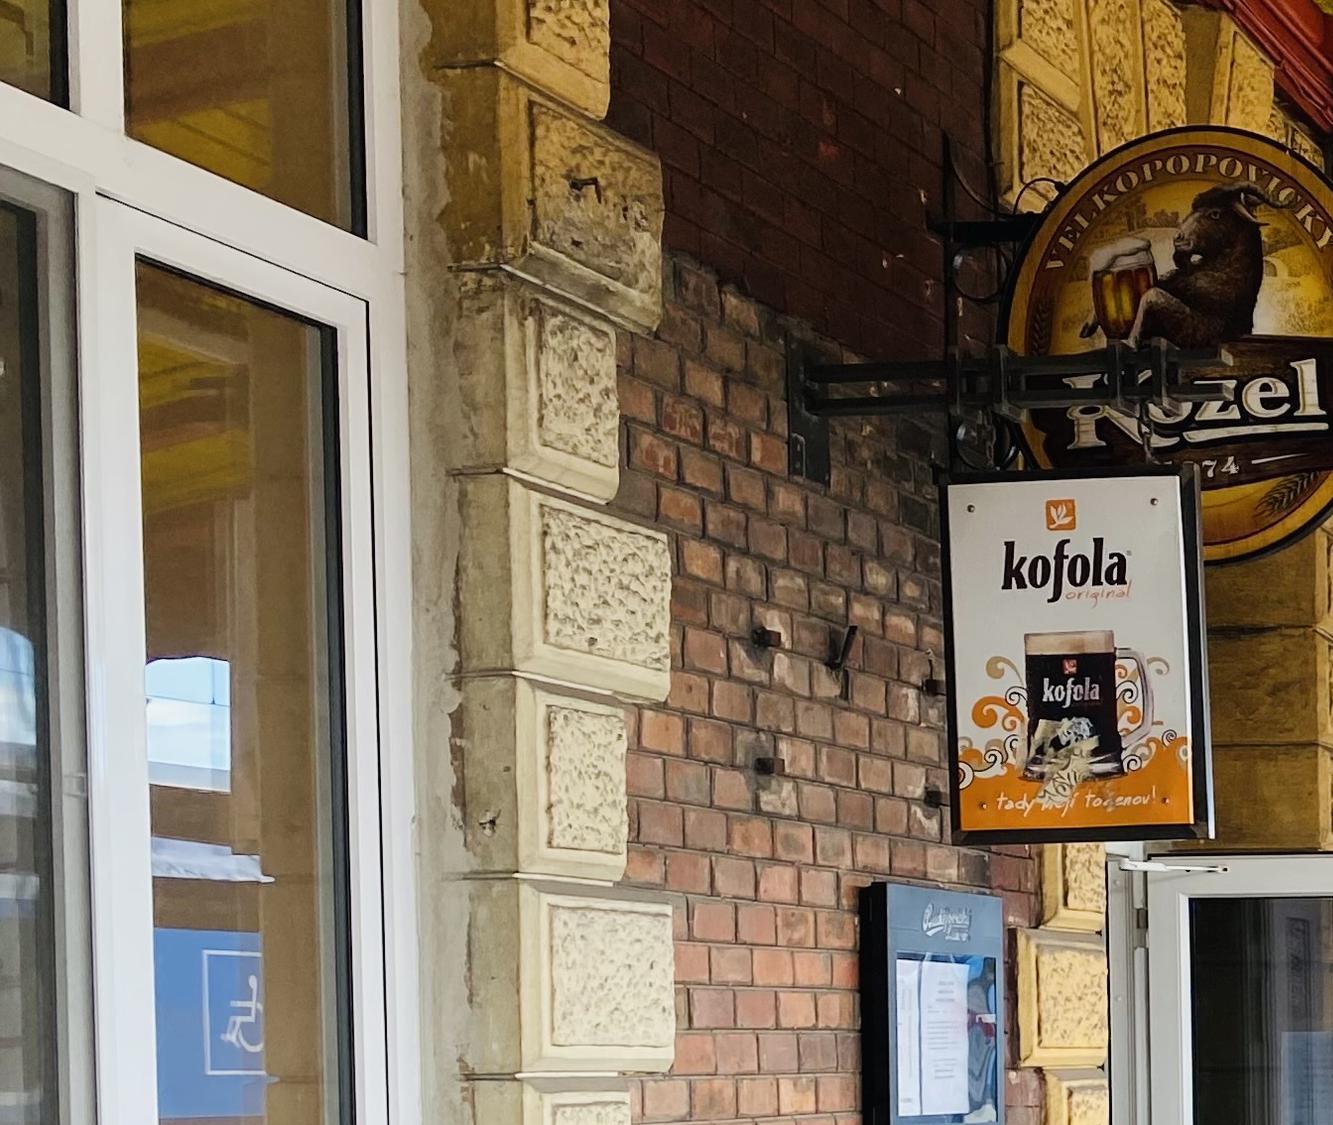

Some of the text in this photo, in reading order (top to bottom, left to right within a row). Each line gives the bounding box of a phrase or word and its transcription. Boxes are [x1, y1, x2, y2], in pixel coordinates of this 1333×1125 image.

[1001, 537, 1127, 603] kofola
[1065, 580, 1132, 608] original
[1042, 676, 1100, 708] kofola
